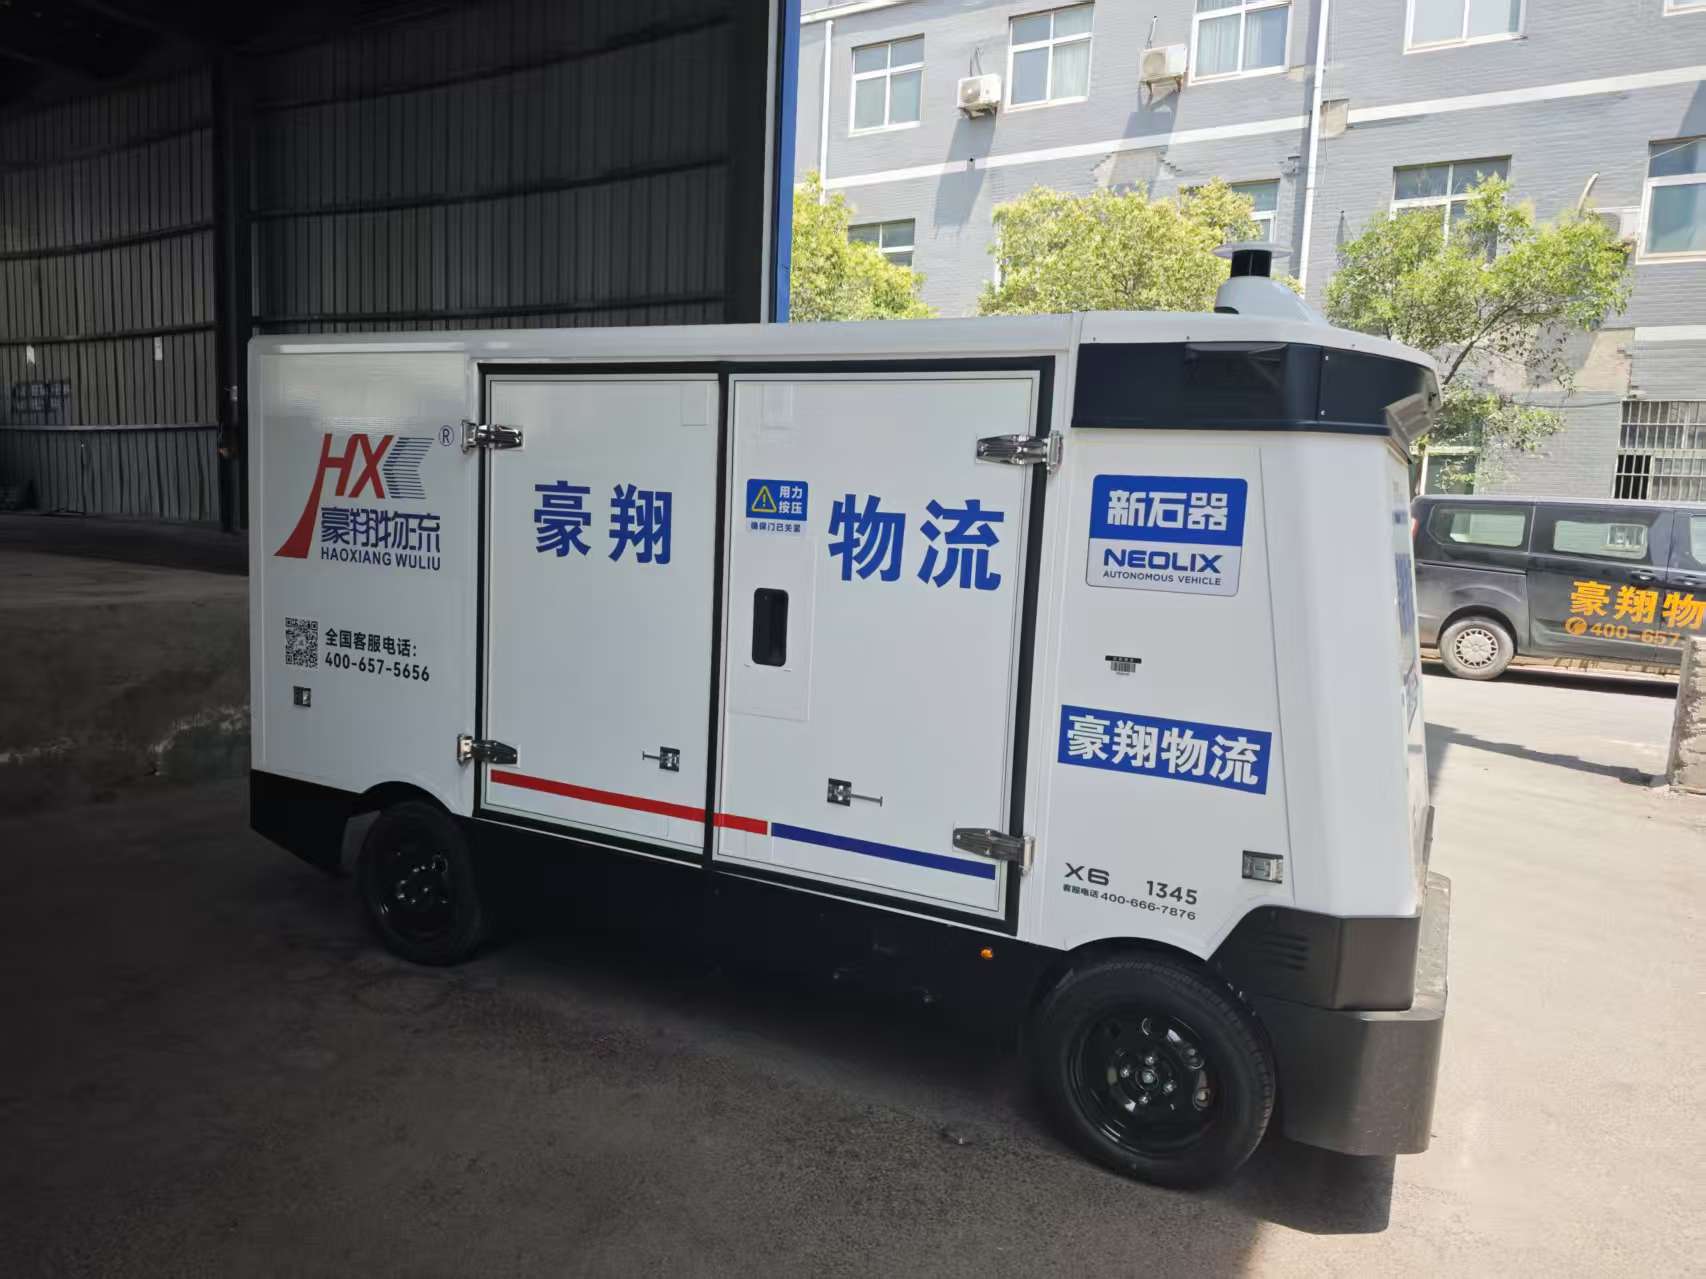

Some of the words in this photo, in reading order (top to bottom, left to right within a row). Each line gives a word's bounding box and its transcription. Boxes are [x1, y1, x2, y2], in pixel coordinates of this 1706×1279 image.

[779, 485, 803, 499] 用力
[778, 500, 803, 514] 按压
[1107, 490, 1229, 531] 新石器
[320, 507, 441, 553] 豪翔物流
[320, 546, 392, 567] HAOXIANG
[394, 552, 441, 571] WULIU
[1103, 548, 1223, 574] NEOLIX
[1102, 569, 1175, 583] AUTONOMOUS
[1177, 575, 1222, 586] VEHICLE
[1569, 580, 1706, 629] 豪翔物
[324, 651, 430, 682] 400-657-5656
[1066, 714, 1261, 785] 豪翔物流
[1064, 862, 1110, 886] X6
[1146, 880, 1198, 905] 1345
[1099, 892, 1197, 921] 400-666-7876
